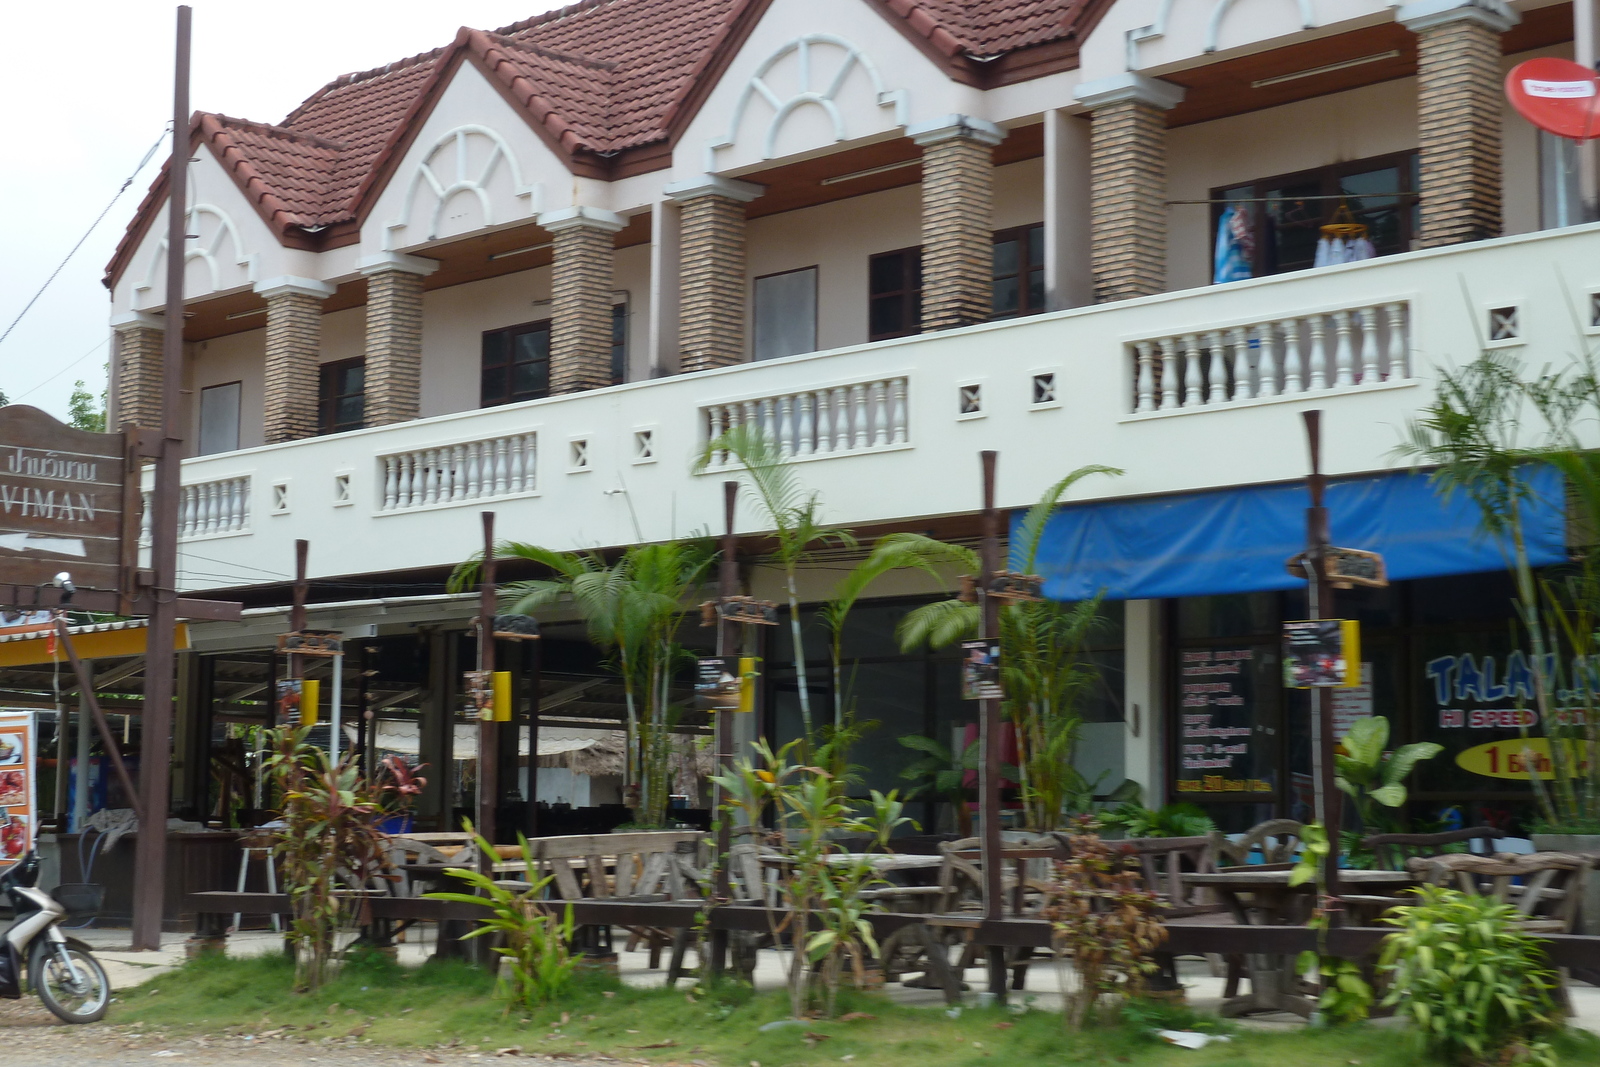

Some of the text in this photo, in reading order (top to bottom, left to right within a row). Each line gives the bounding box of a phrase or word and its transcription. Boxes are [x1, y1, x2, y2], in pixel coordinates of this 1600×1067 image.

[1, 484, 96, 522] VIMAN
[1439, 709, 1465, 728] HI
[1468, 708, 1539, 728] SPEED
[1485, 746, 1500, 773] 1
